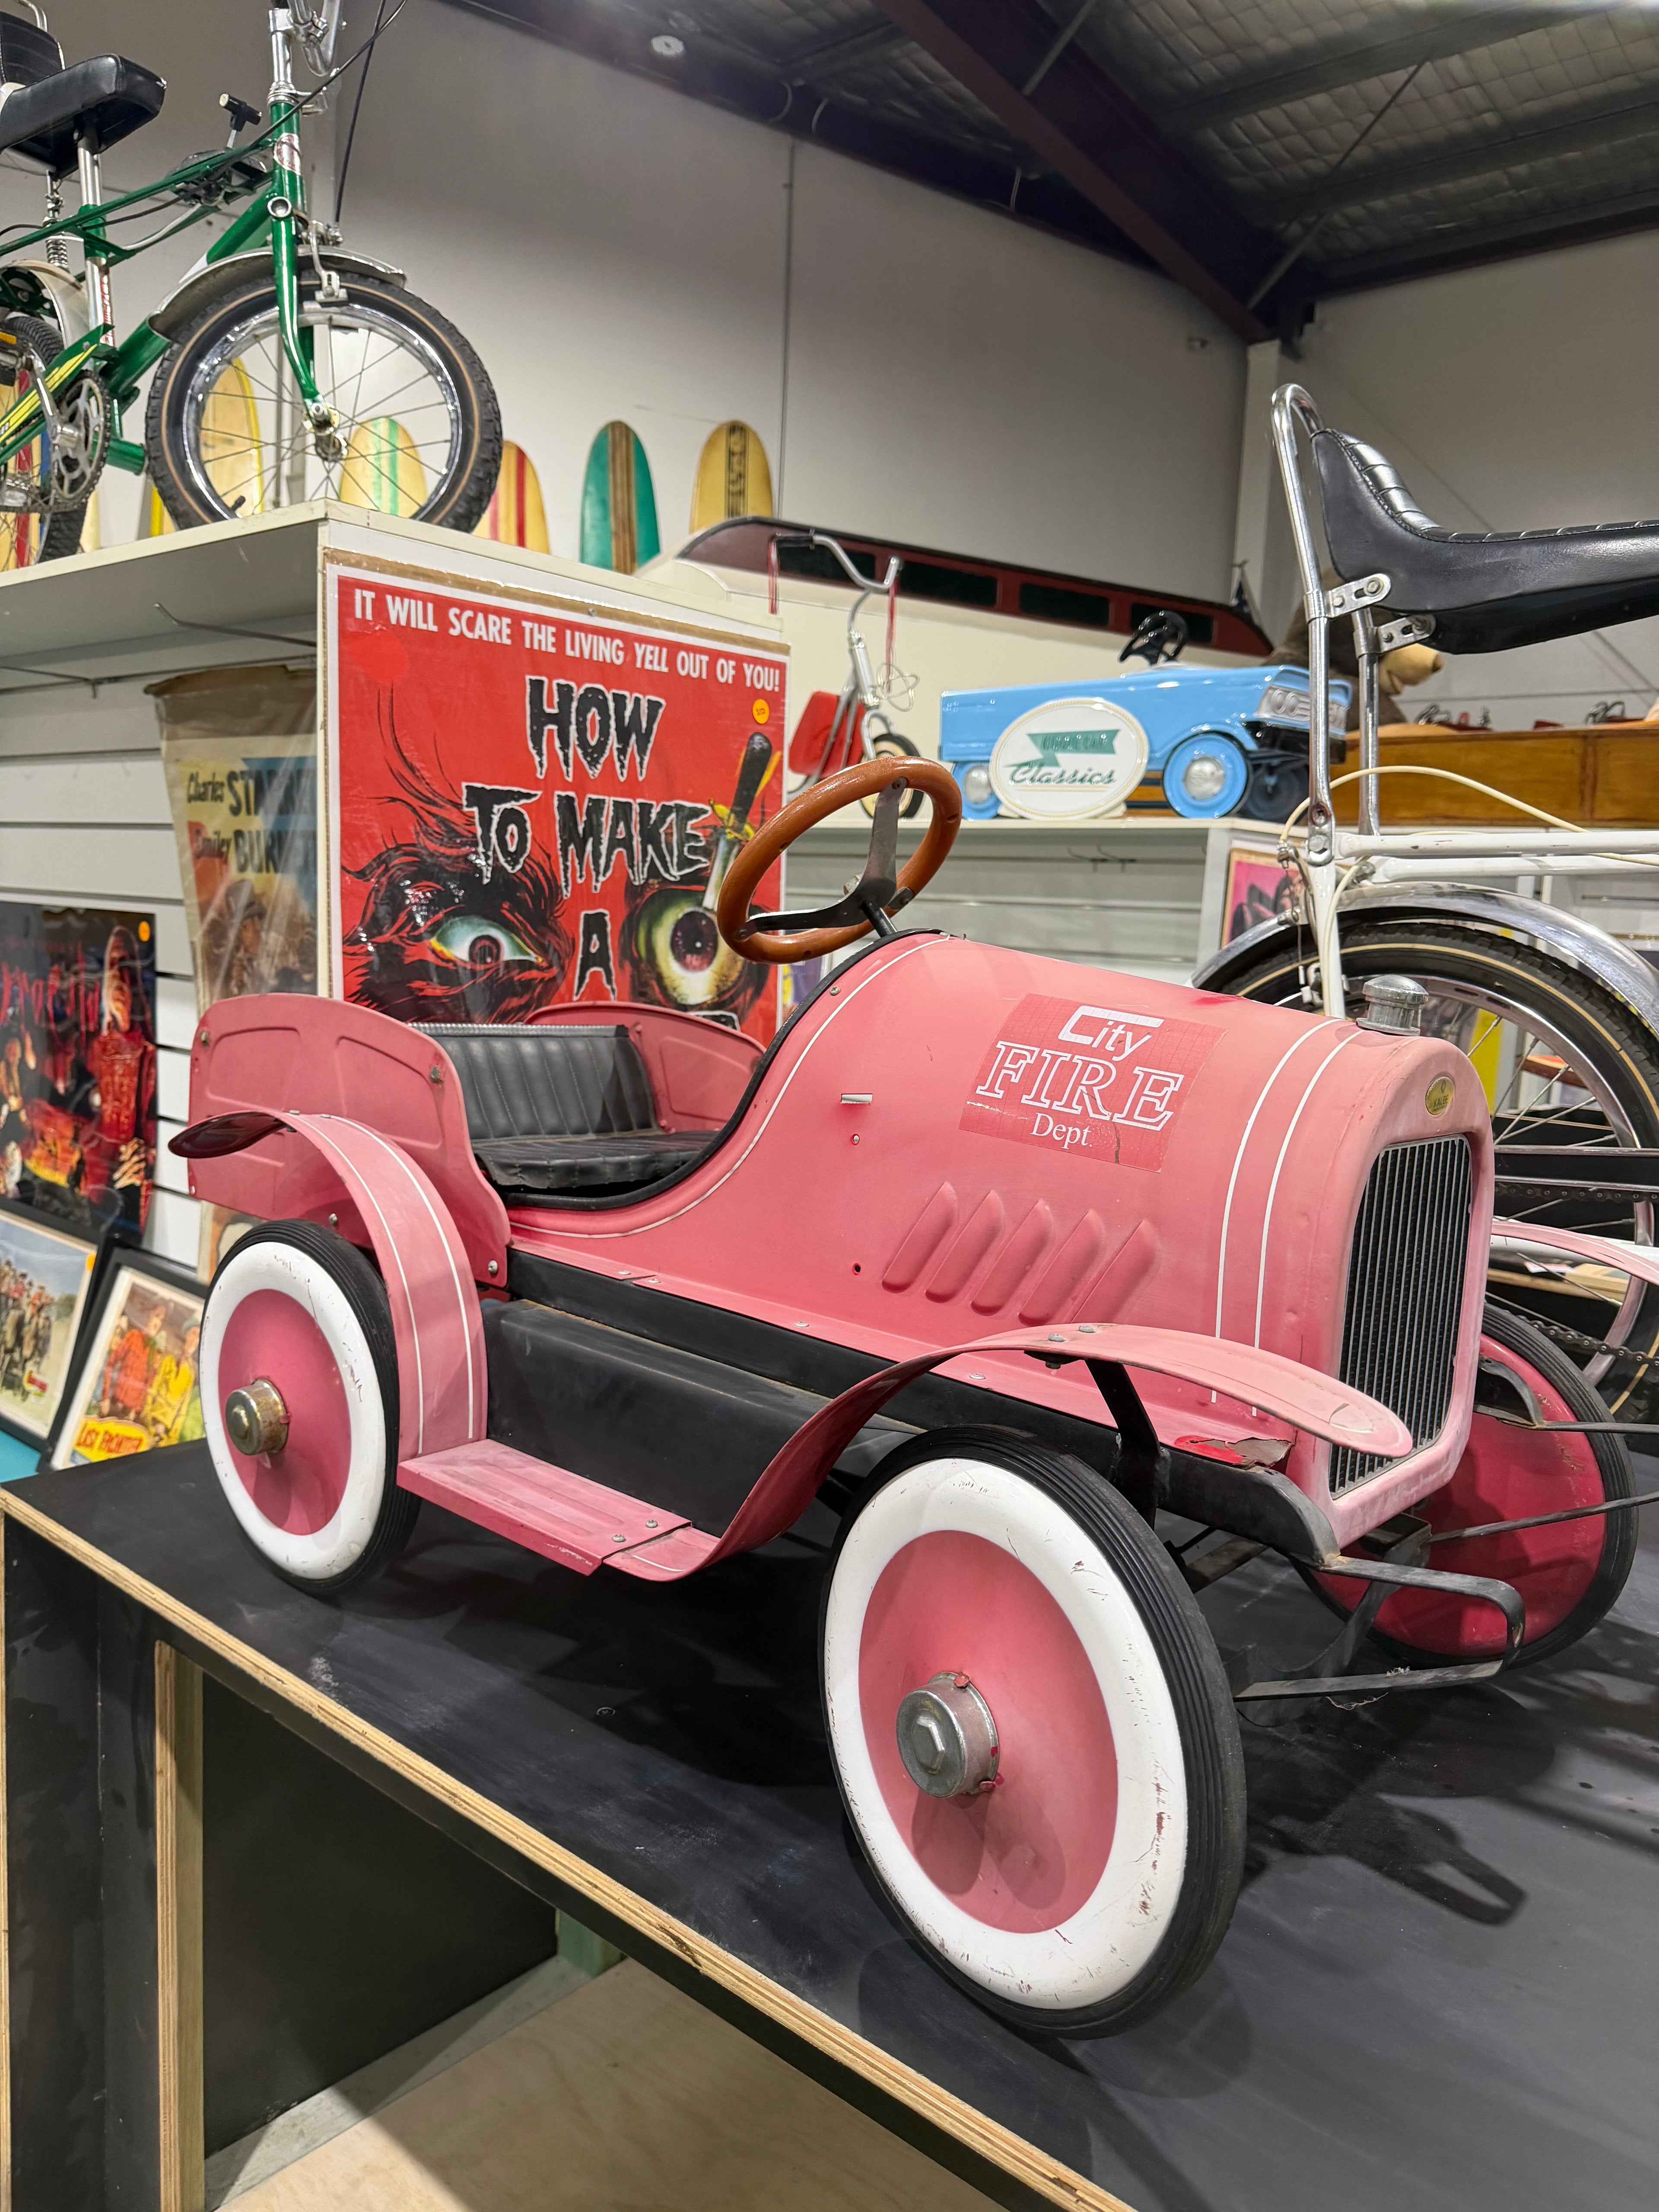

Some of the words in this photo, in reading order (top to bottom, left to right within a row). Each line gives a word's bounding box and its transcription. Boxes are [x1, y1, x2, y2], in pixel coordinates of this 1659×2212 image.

[355, 589, 375, 620] IT
[386, 594, 438, 632] WILL
[448, 607, 512, 645] SCARE
[521, 620, 556, 653] THE
[565, 629, 625, 665] LIVING
[634, 642, 669, 673] YELL
[676, 651, 709, 679] OUT
[716, 658, 736, 684] OF
[743, 663, 780, 692] YOU!
[525, 675, 666, 782] HOW
[1009, 760, 1116, 785] Classics
[461, 782, 543, 885] TO
[553, 791, 712, 899] MAKE
[573, 909, 617, 1002] A
[1058, 1005, 1164, 1062] City
[976, 1040, 1185, 1131] FIRE
[1030, 1112, 1092, 1149] Dept.
